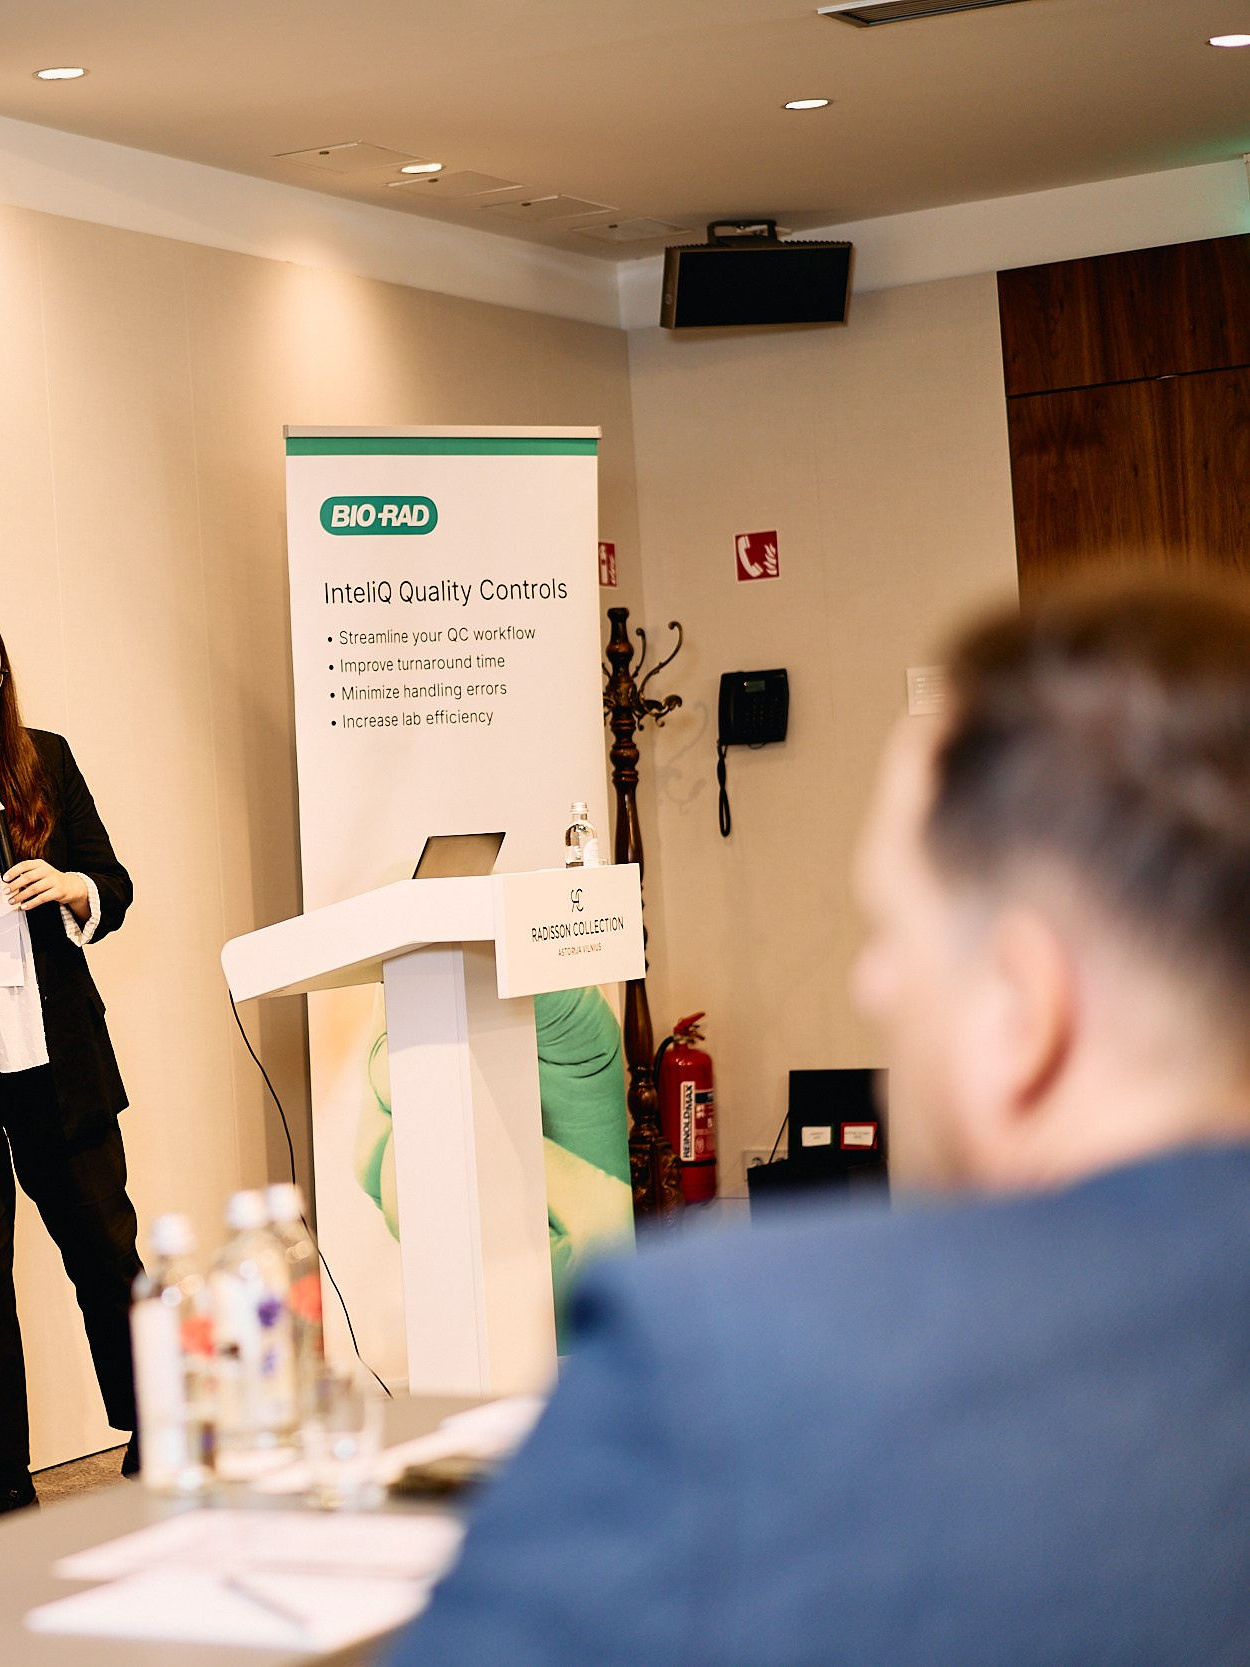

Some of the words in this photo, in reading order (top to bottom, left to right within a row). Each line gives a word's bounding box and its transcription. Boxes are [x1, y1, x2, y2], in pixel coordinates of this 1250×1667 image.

[331, 503, 430, 528] BIO-RAD
[324, 581, 393, 604] InteliQ
[399, 579, 473, 607] Quality
[479, 578, 568, 601] Controls
[339, 629, 409, 645] Streamline
[412, 631, 443, 647] your
[447, 627, 470, 643] QC
[473, 626, 536, 641] workflow
[339, 658, 394, 676] Improve
[397, 655, 473, 672] turnaround
[476, 654, 505, 669] time
[341, 685, 400, 702] Minimize
[403, 682, 462, 701] handling
[466, 683, 507, 696] errors
[342, 712, 399, 729] Increase
[402, 711, 422, 727] lab
[426, 709, 494, 728] efficiency
[531, 923, 571, 943] RADISSON
[573, 916, 624, 937] COLLECTION
